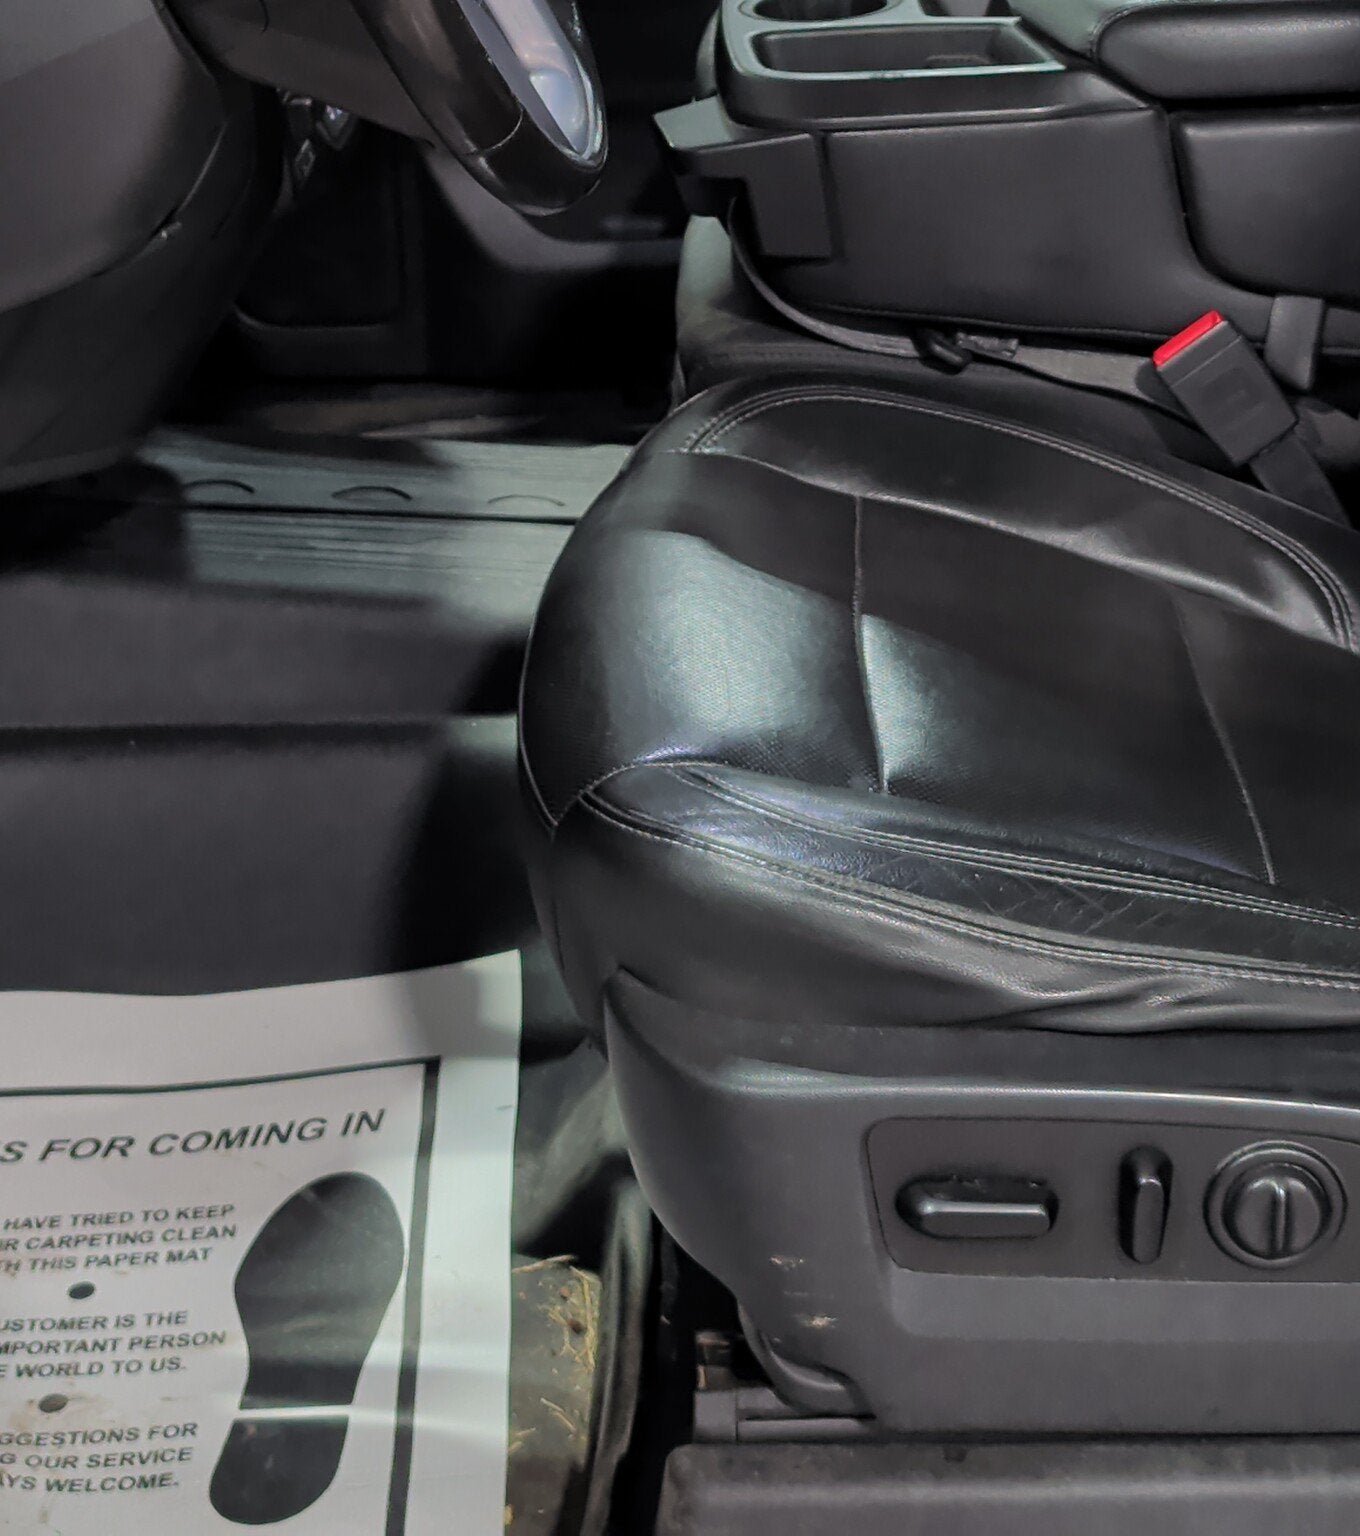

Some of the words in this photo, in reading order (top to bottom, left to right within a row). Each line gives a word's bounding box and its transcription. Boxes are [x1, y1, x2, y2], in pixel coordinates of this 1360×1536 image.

[39, 1135, 136, 1162] FOR
[148, 1116, 328, 1156] COMING
[340, 1108, 386, 1137] IN
[3, 1215, 61, 1231] HAVE
[71, 1211, 134, 1228] TRIED
[142, 1208, 169, 1223] TO
[176, 1203, 235, 1221] KEEP
[26, 1230, 154, 1251] CARPETING
[161, 1224, 237, 1243] CLEAN
[30, 1255, 76, 1272] THIS
[85, 1250, 159, 1268] PAPER
[166, 1247, 212, 1264] MAT
[114, 1314, 136, 1328] IS
[144, 1310, 189, 1327] THE
[128, 1330, 226, 1351] PERSON
[16, 1360, 104, 1378] WORLD
[112, 1359, 143, 1375] TO
[151, 1356, 187, 1372] US.
[147, 1422, 198, 1440] FOR
[24, 1453, 78, 1469] OUR
[86, 1446, 194, 1468] SERVICE
[44, 1472, 179, 1494] WELCOME.
